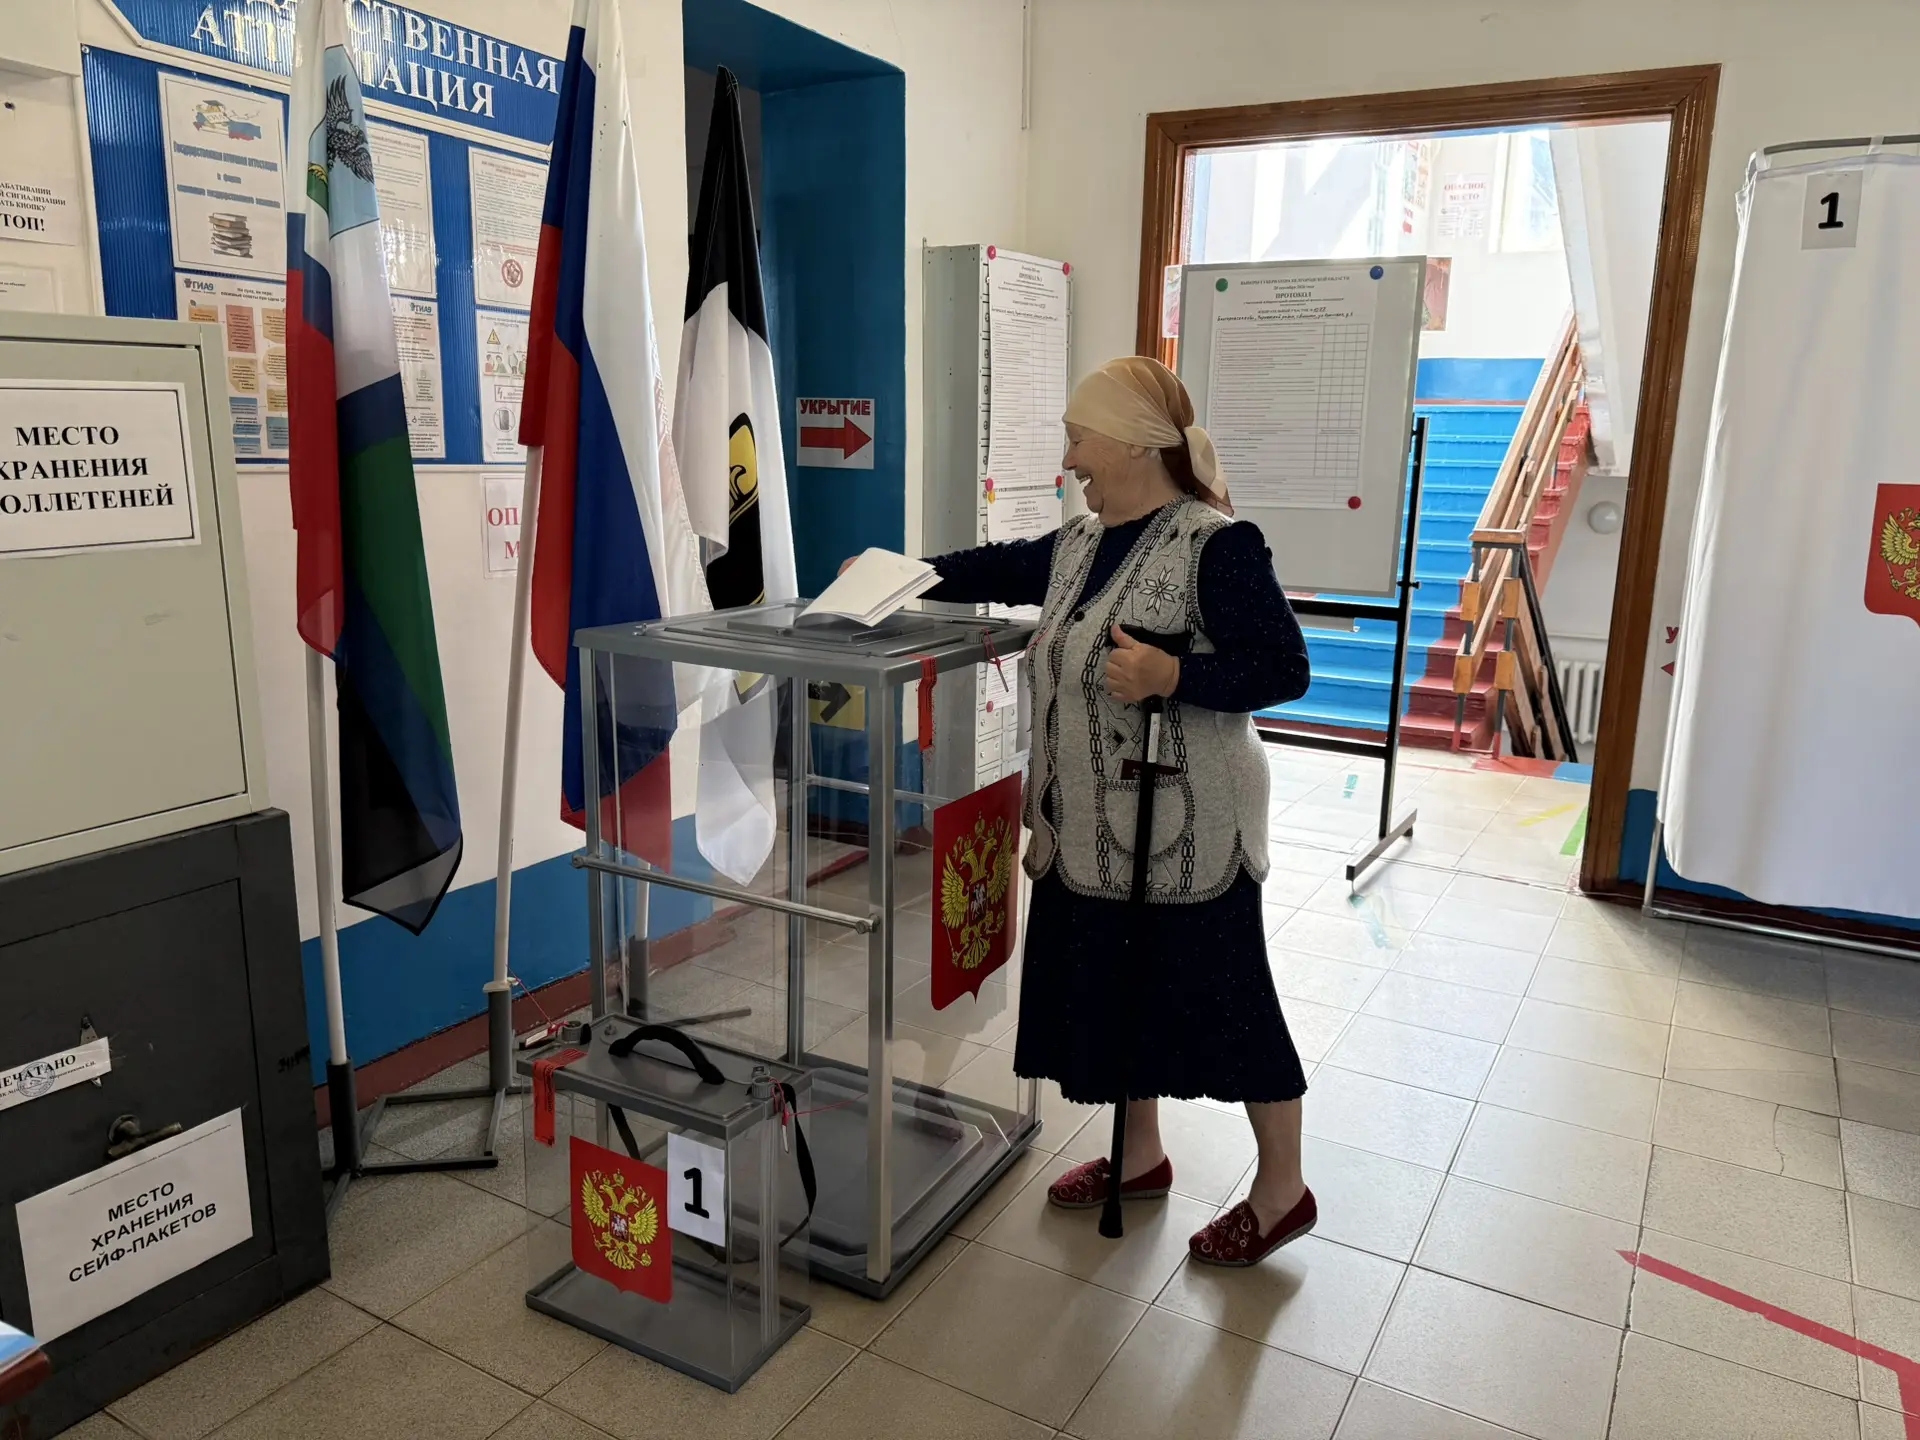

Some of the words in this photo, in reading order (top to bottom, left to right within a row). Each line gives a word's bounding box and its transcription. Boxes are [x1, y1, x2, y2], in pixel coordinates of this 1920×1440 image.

[190, 6, 495, 119] АТТТАЦИЯ
[247, 0, 560, 95] СТВЕННАЯ
[16, 202, 47, 212] КНОПКУ
[1818, 192, 1844, 230] 1
[800, 399, 871, 415] УКРЫТИЕ
[15, 426, 120, 446] МЕСТО
[0, 1054, 77, 1088] ЕЧАТАНО
[108, 1182, 174, 1222] МЕСТО
[683, 1167, 710, 1219] 1
[91, 1193, 193, 1251] ХРАНЕНИЯ
[69, 1203, 217, 1282] СЕЙФ-ПАКЕТОВ
